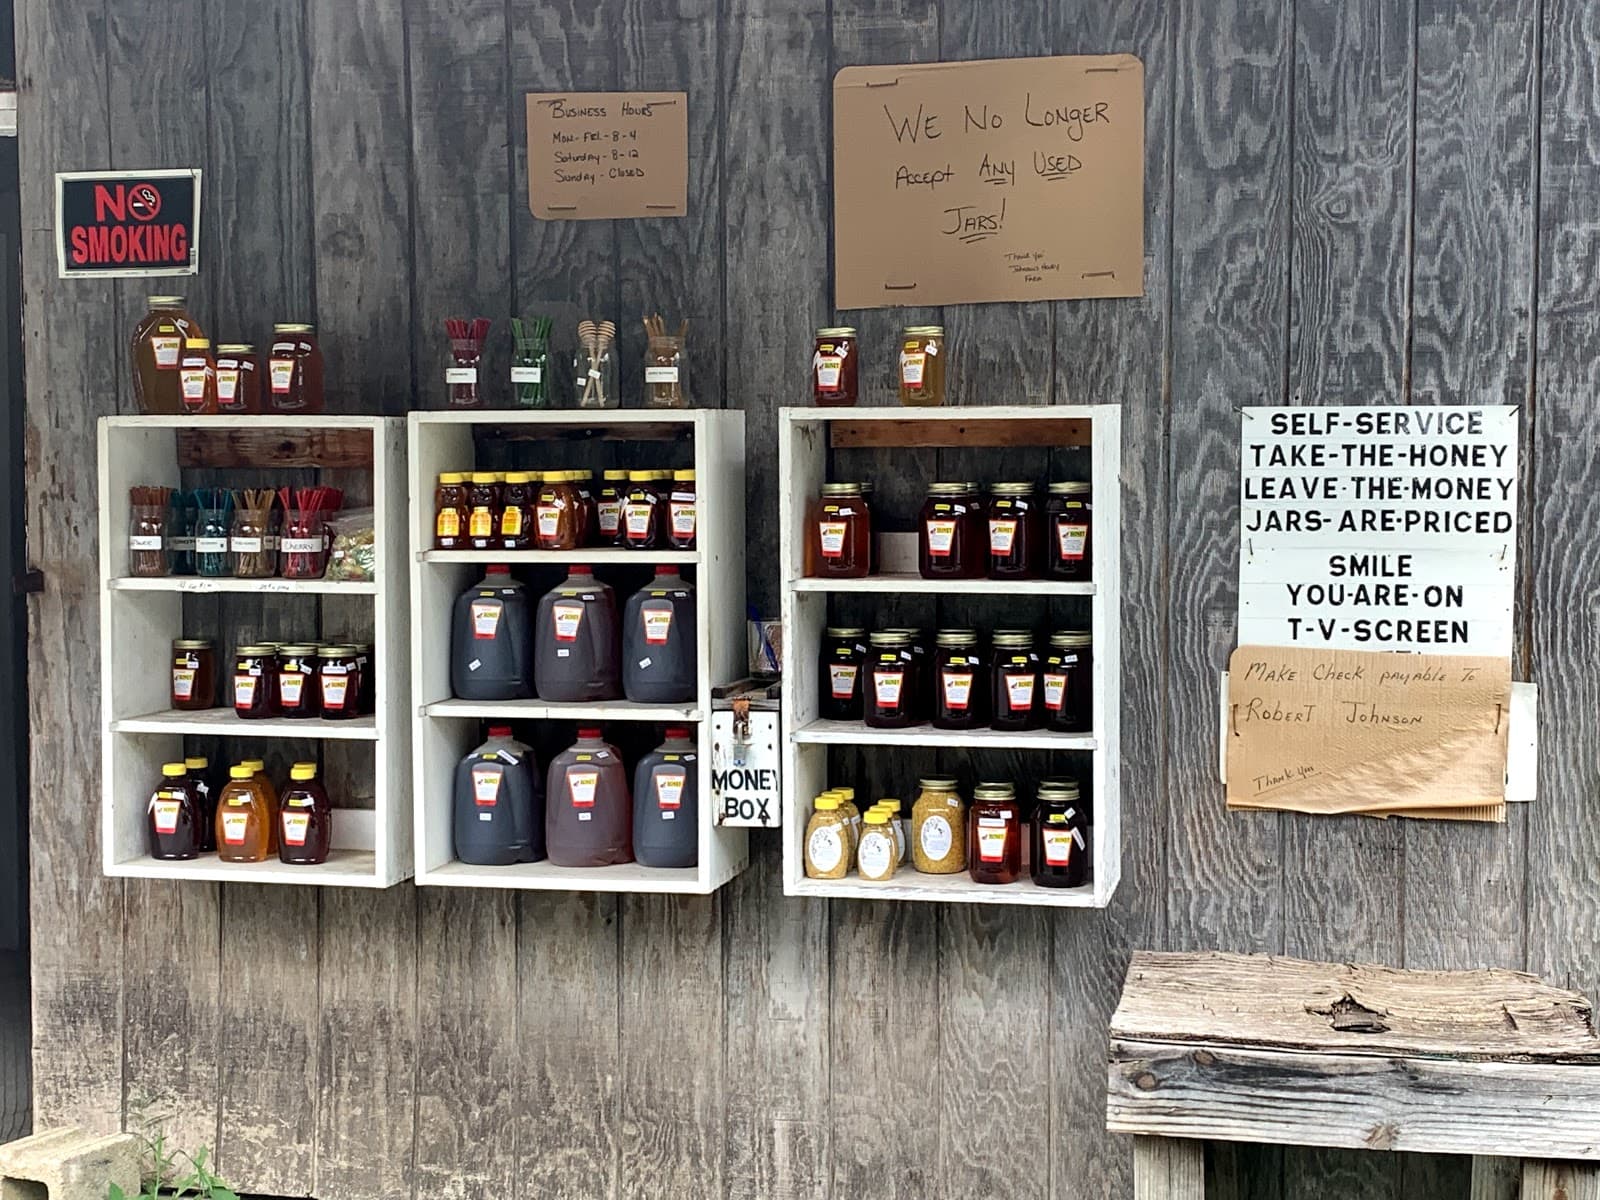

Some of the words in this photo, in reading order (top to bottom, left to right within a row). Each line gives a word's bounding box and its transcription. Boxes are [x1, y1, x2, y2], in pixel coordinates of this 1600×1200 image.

[883, 103, 942, 144] WE
[978, 153, 1016, 186] ANY
[1033, 151, 1082, 175] USED
[941, 198, 1006, 236] JARS!
[71, 223, 188, 264] SMOKING
[1270, 411, 1484, 436] SELF-SERVICE
[1329, 555, 1412, 577] SMILE
[725, 797, 770, 820] BOX
